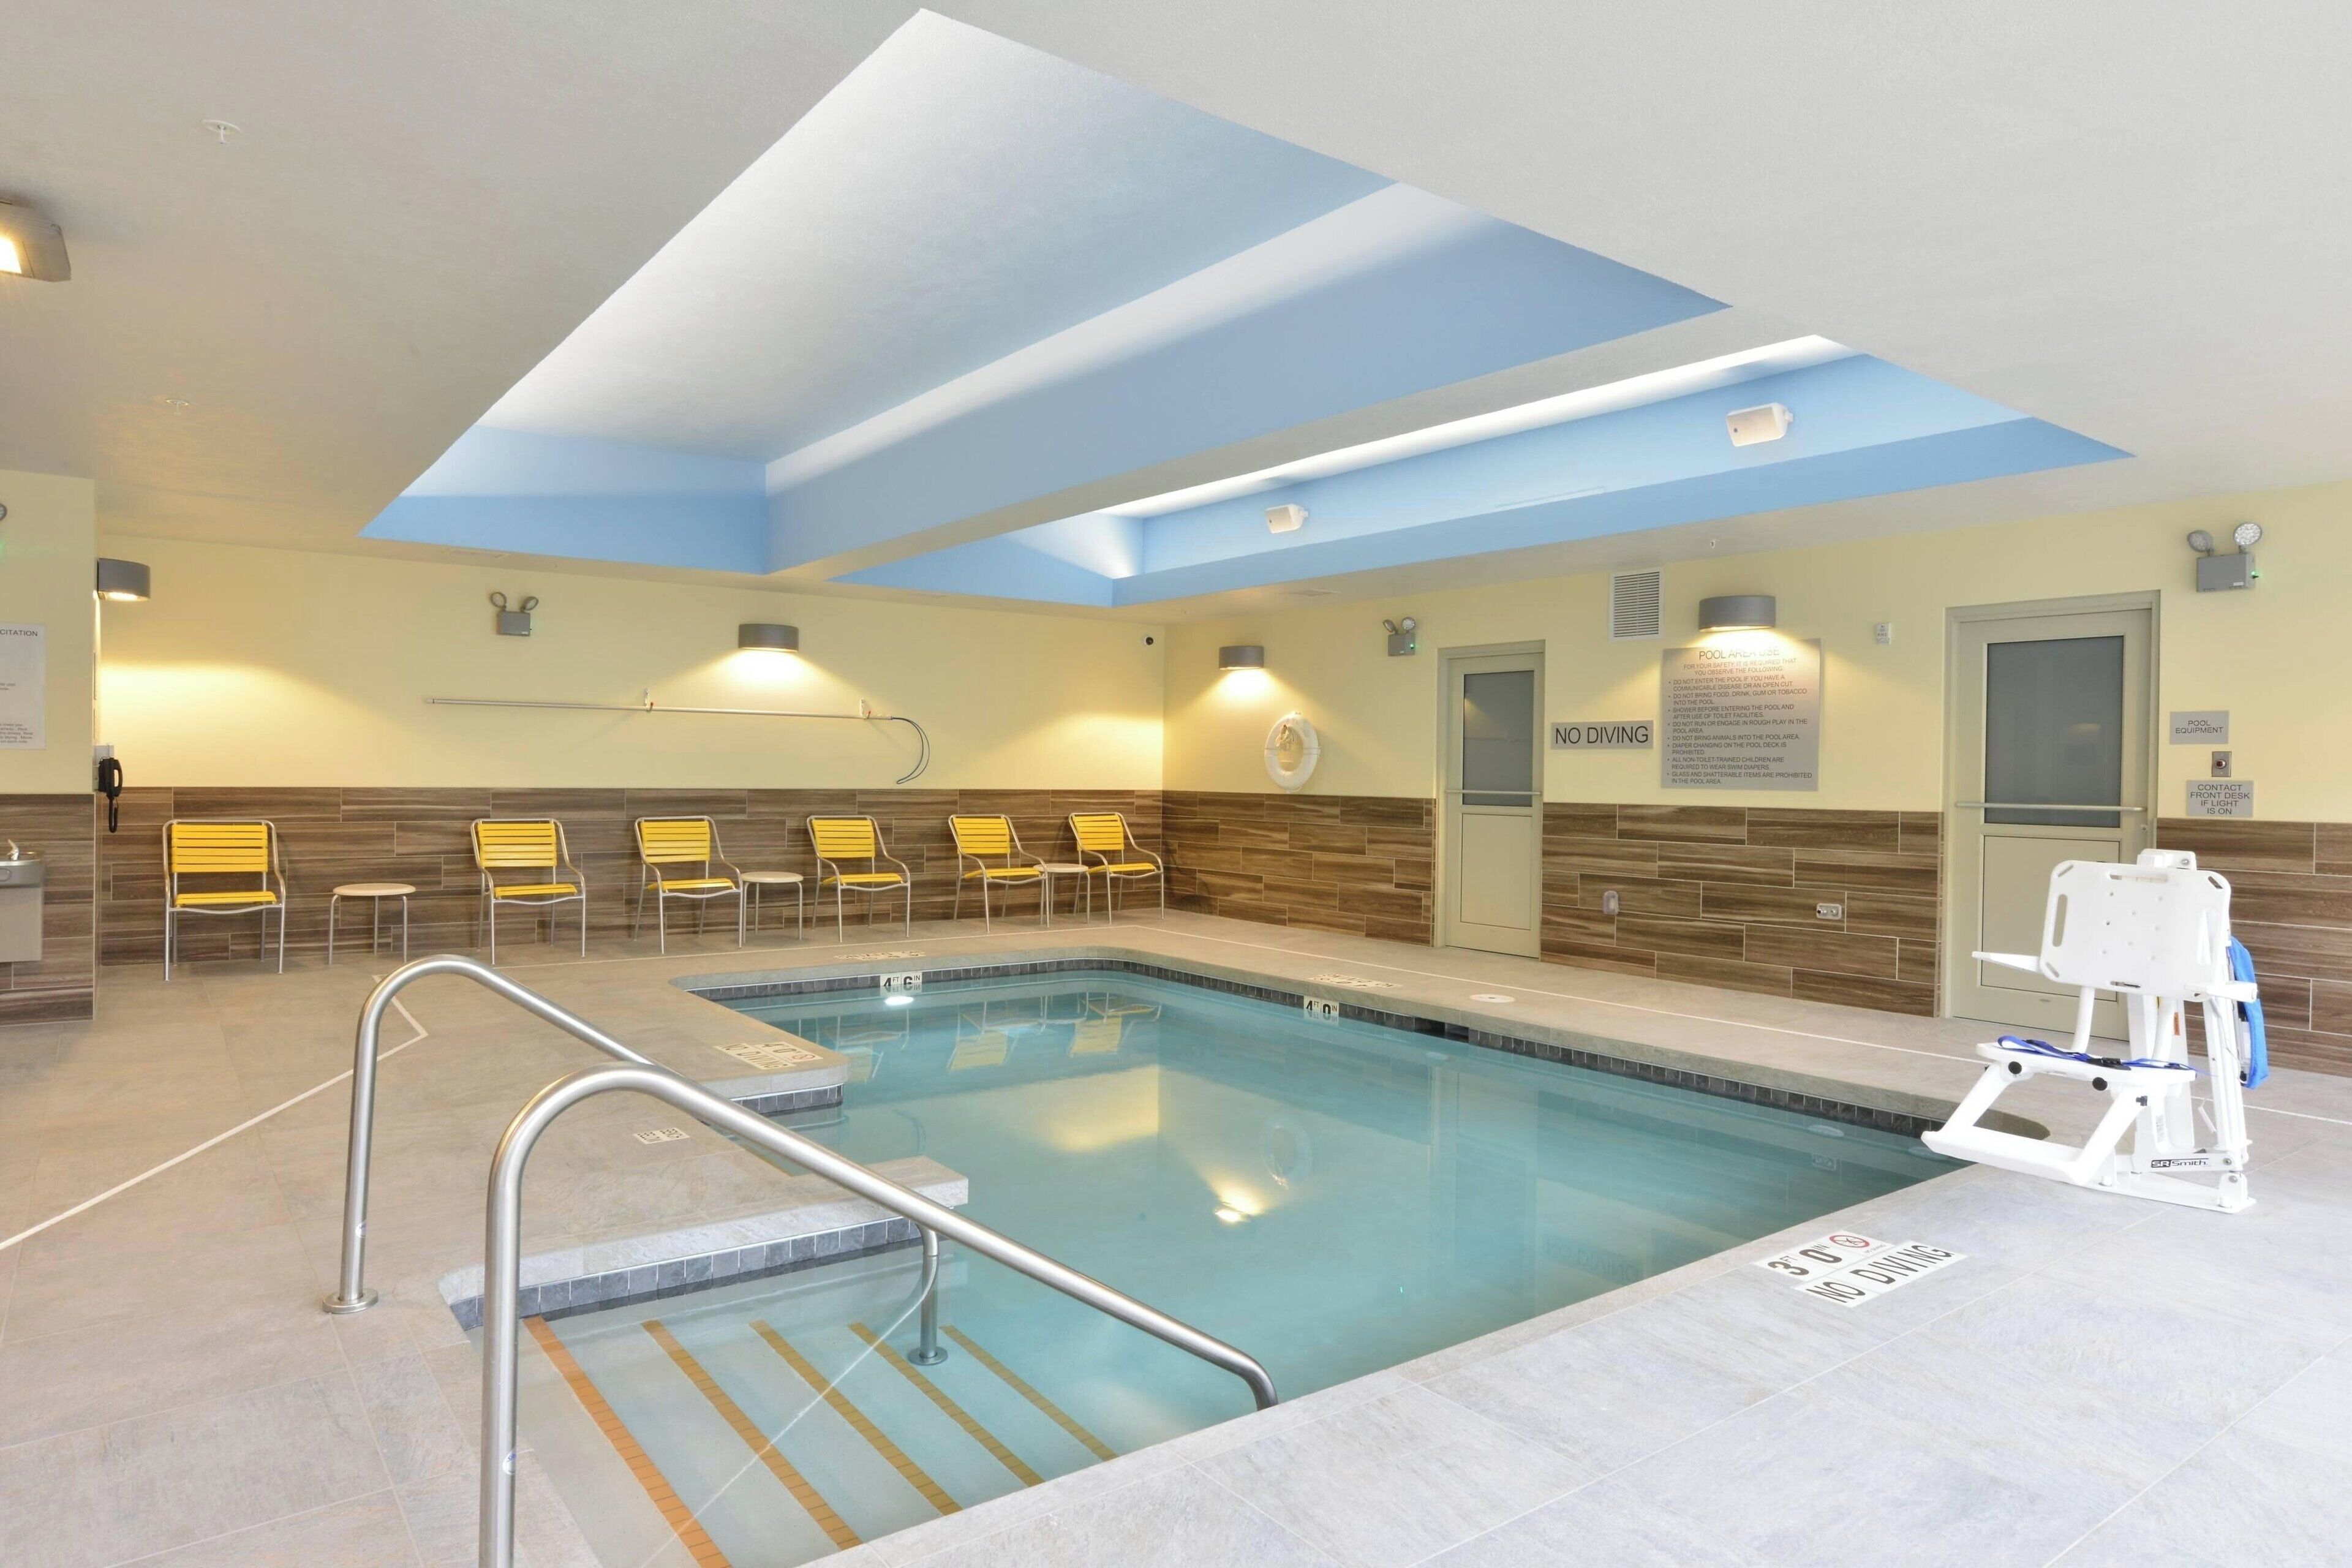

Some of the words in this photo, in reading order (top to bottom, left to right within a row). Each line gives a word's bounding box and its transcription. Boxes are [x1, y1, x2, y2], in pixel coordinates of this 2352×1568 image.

[1699, 649, 1726, 660] POOL
[1728, 648, 1756, 658] AREA
[1556, 727, 1581, 744] NO
[1587, 725, 1649, 744] DIVING
[1813, 1243, 1830, 1253] IN
[1799, 1248, 1842, 1264] 0
[1768, 1261, 1809, 1276] 3
[1806, 1281, 1866, 1303] NO
[1849, 1245, 1954, 1285] DIVING
